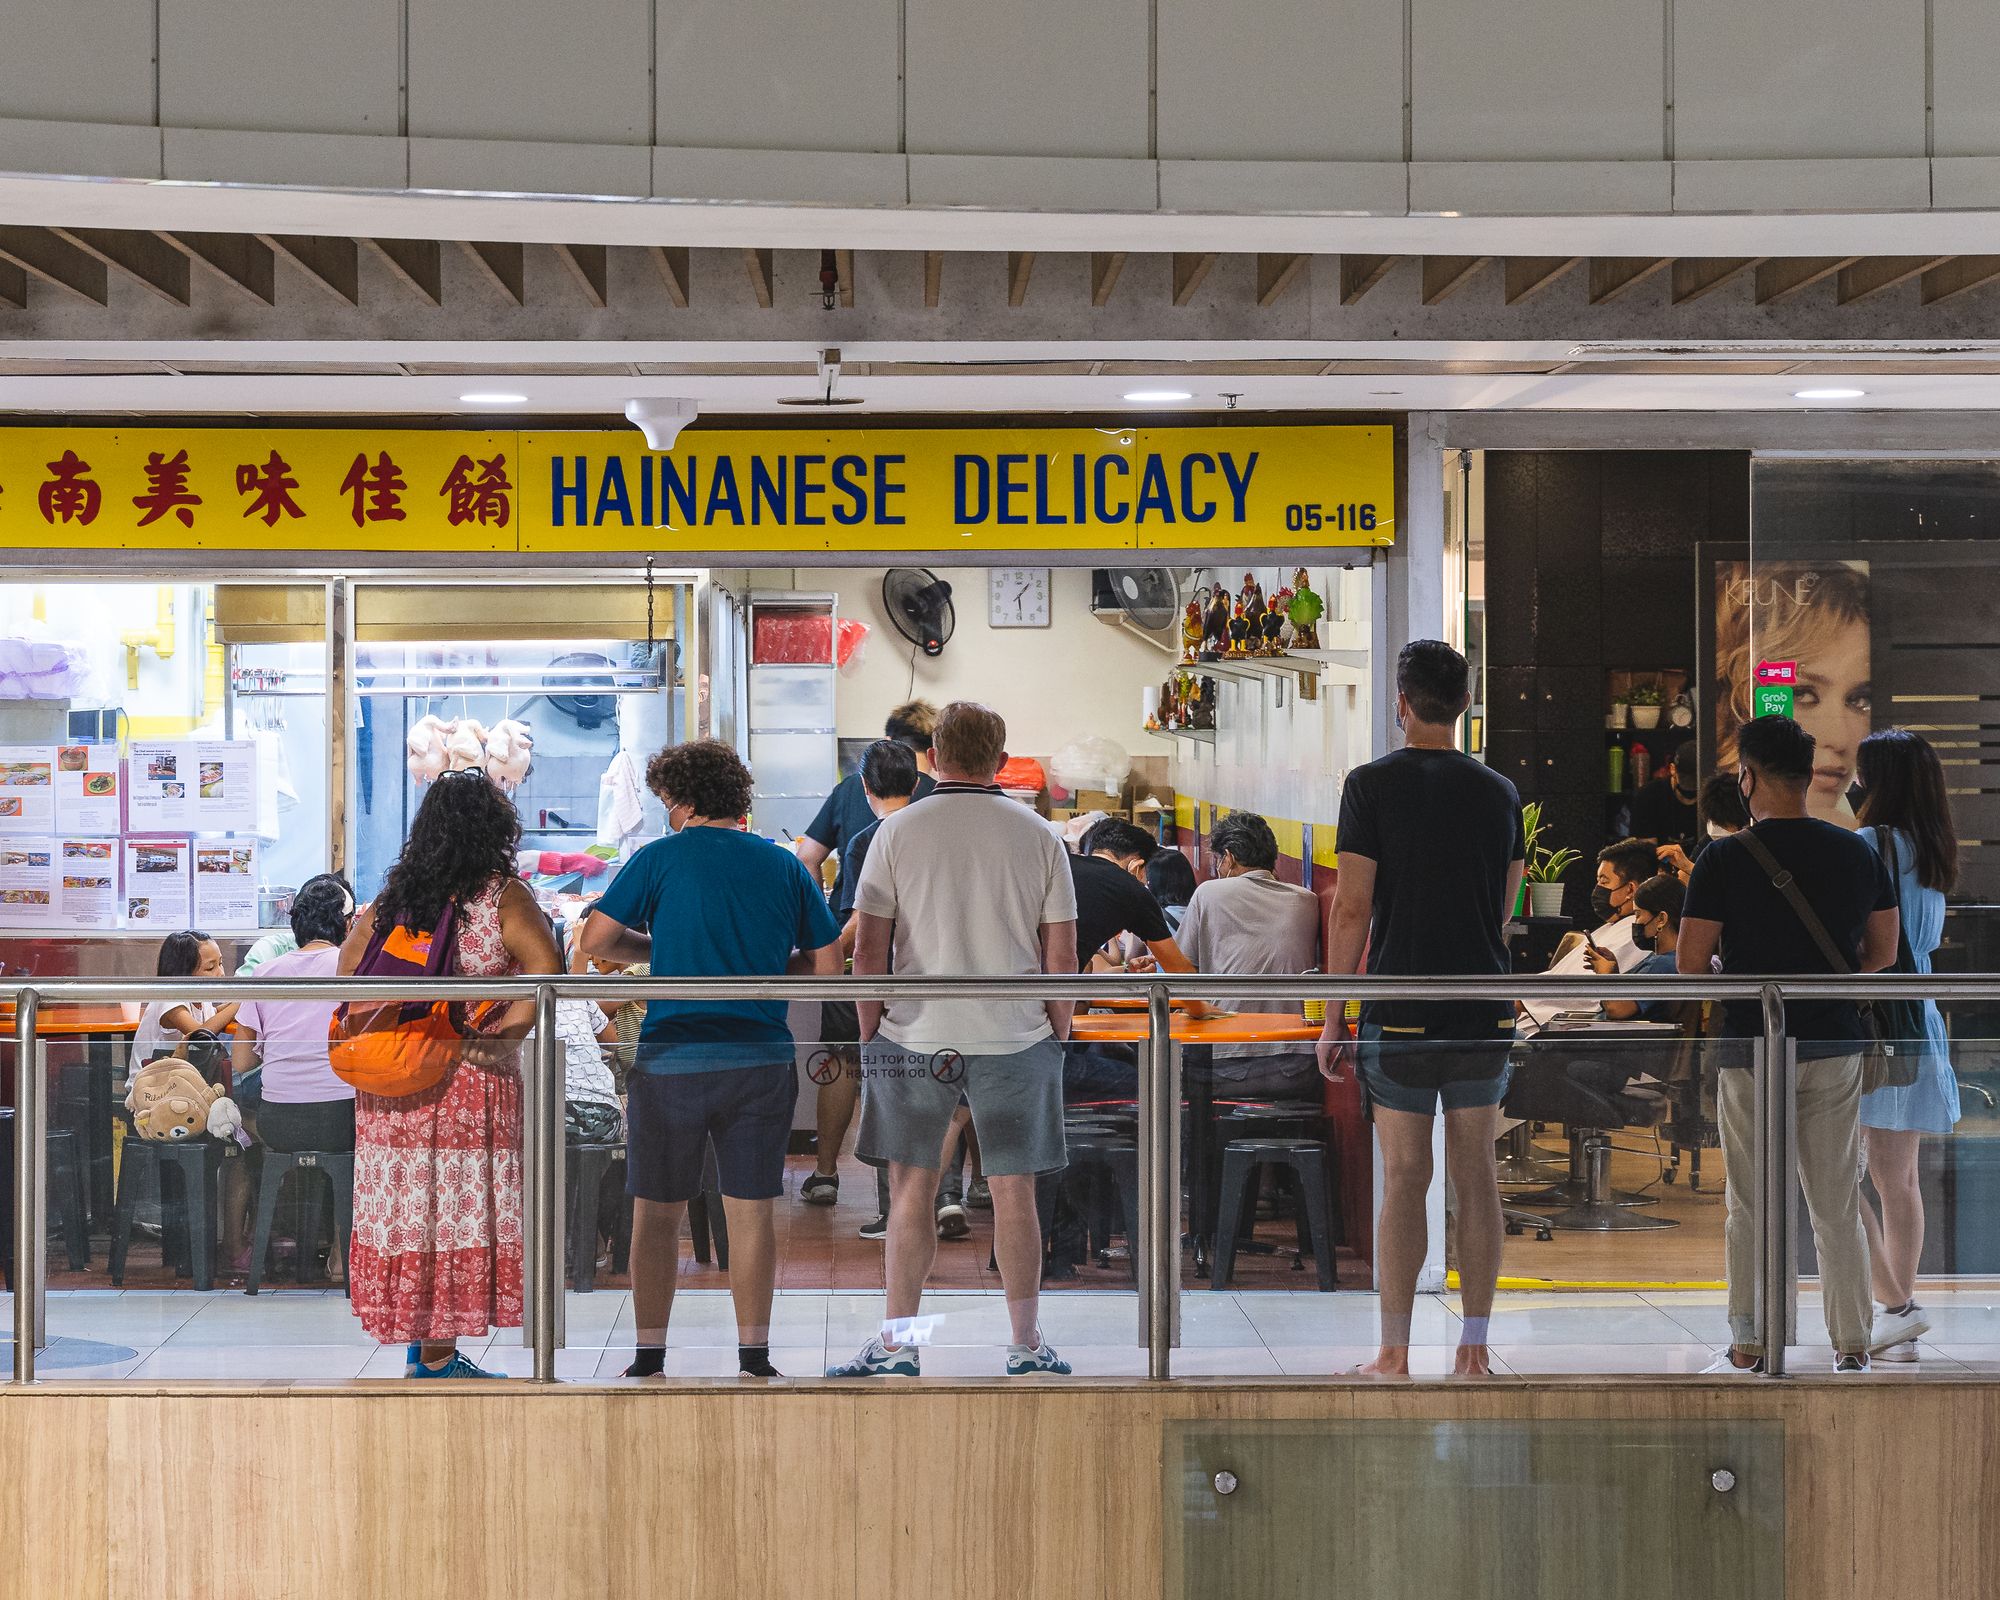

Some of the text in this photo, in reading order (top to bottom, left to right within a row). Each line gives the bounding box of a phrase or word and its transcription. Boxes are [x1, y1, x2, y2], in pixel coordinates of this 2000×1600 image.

[0, 449, 513, 529] 南美味佳餚
[552, 451, 1260, 527] HAINANESE DELICACY
[1285, 503, 1377, 532] 05-116
[1725, 578, 1812, 606] KEUNE
[1761, 691, 1788, 703] Grab
[1764, 702, 1785, 715] Pay
